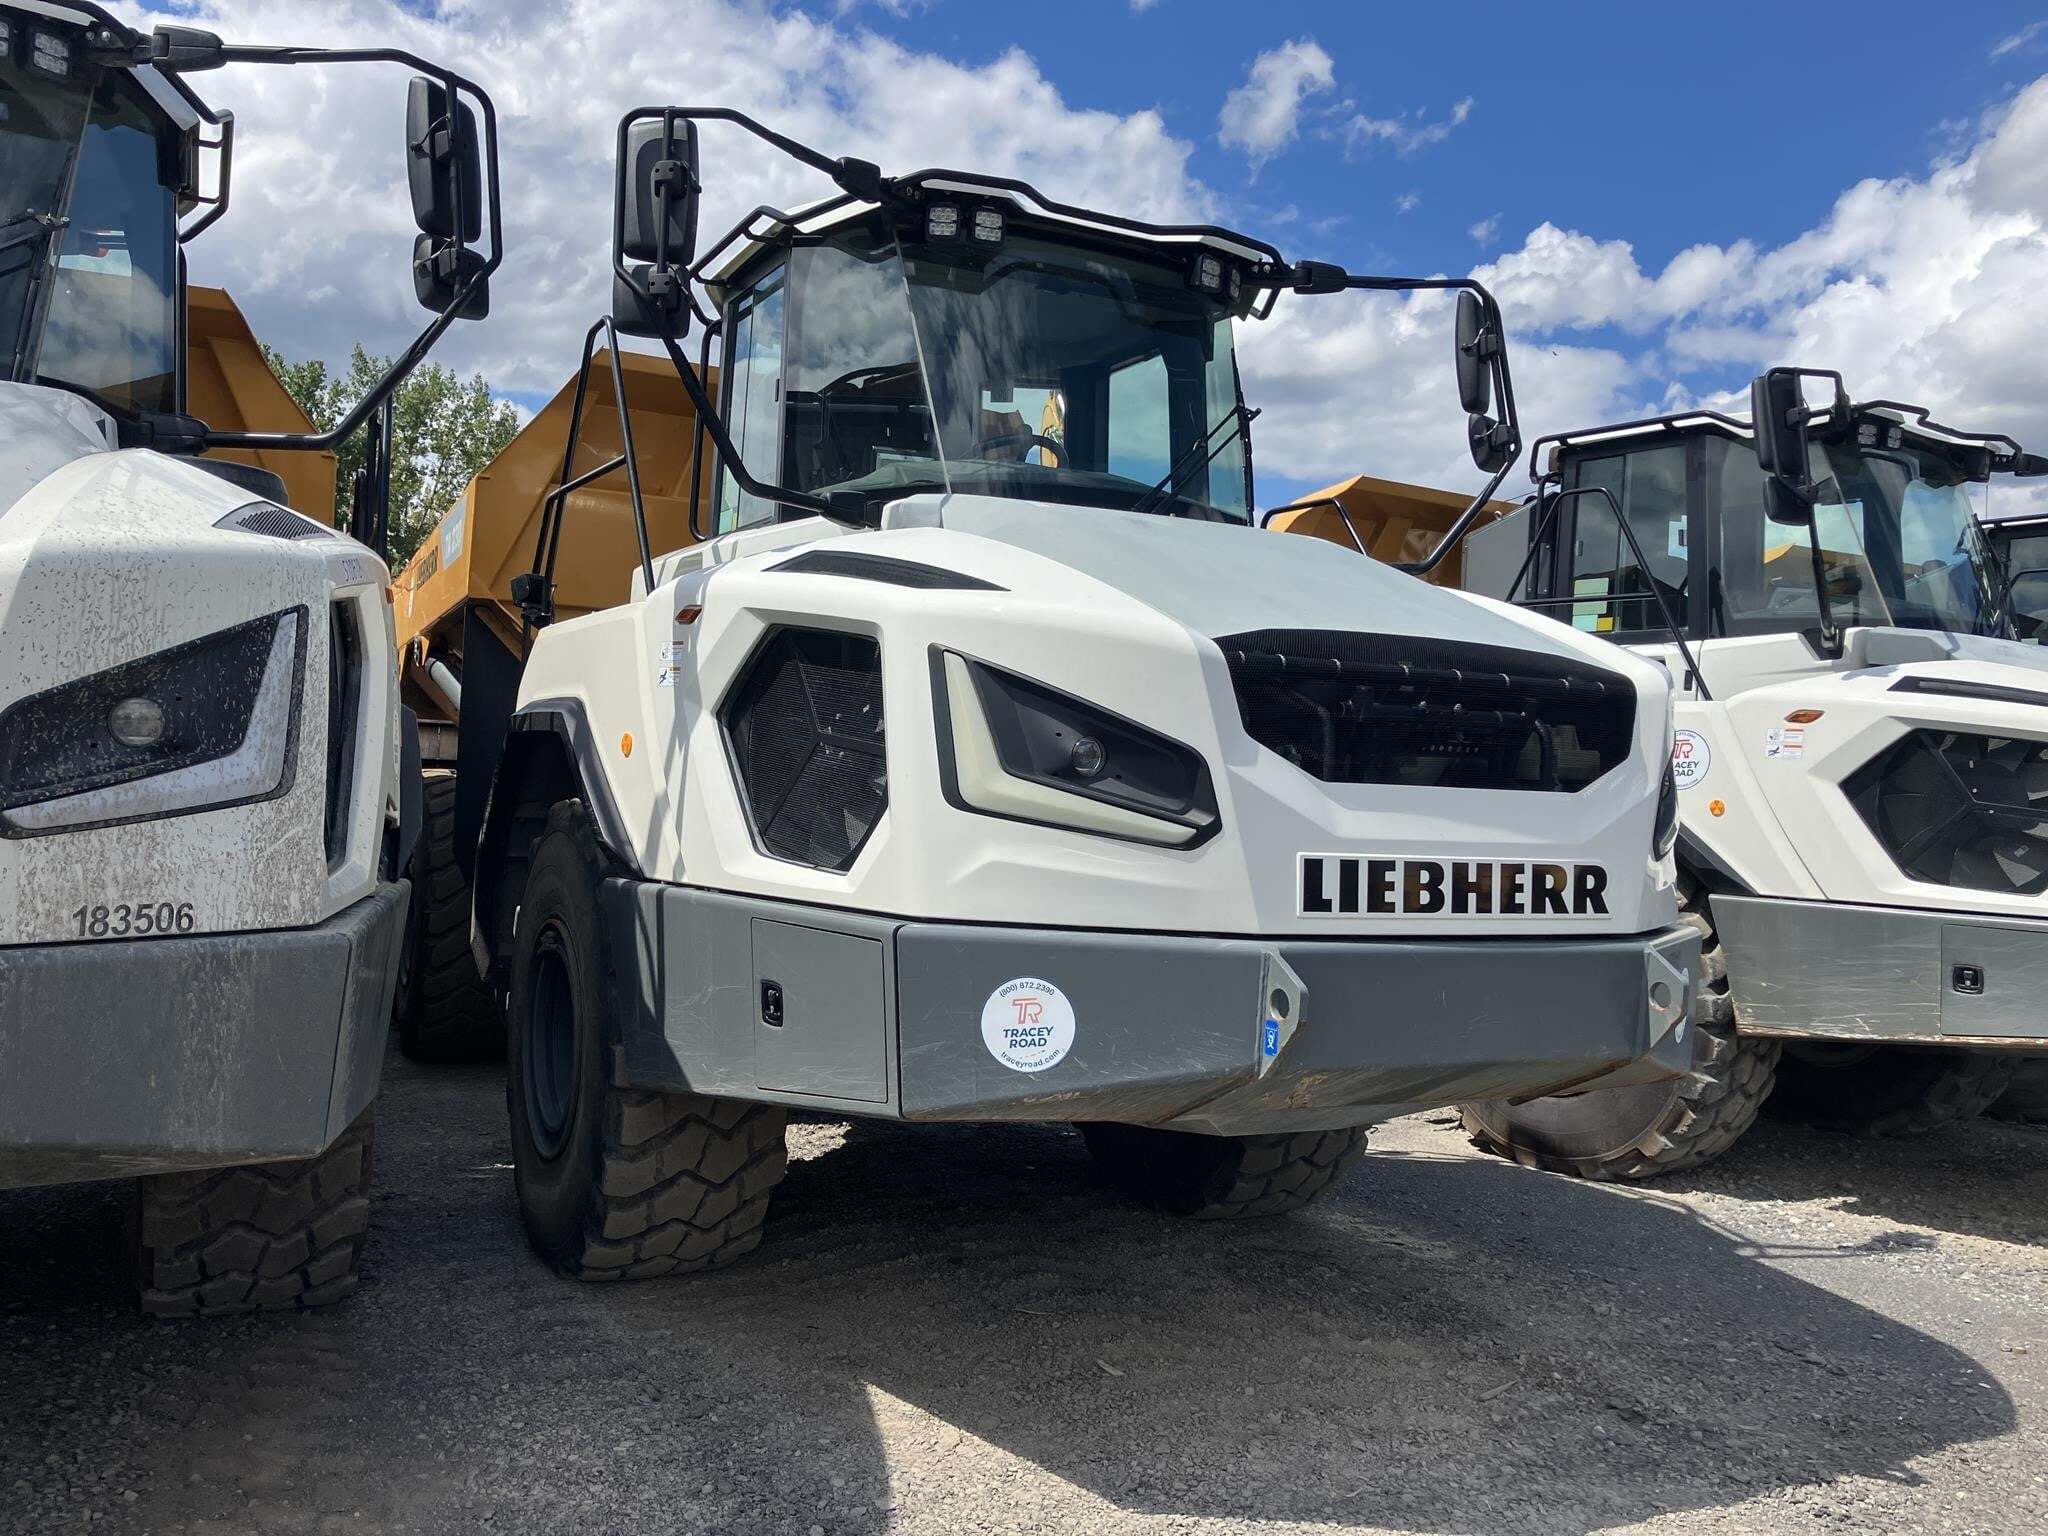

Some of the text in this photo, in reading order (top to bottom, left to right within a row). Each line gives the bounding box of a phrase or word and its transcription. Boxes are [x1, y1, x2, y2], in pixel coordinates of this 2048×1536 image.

[1303, 858, 1609, 914] LIEBHERR
[72, 902, 194, 937] 183506
[1000, 983, 1018, 998] (800)
[1011, 997, 1043, 1025] TR
[1003, 1026, 1053, 1038] TRACEY
[1009, 1037, 1047, 1048] ROAD
[1001, 1049, 1060, 1069] traceyroad.com
